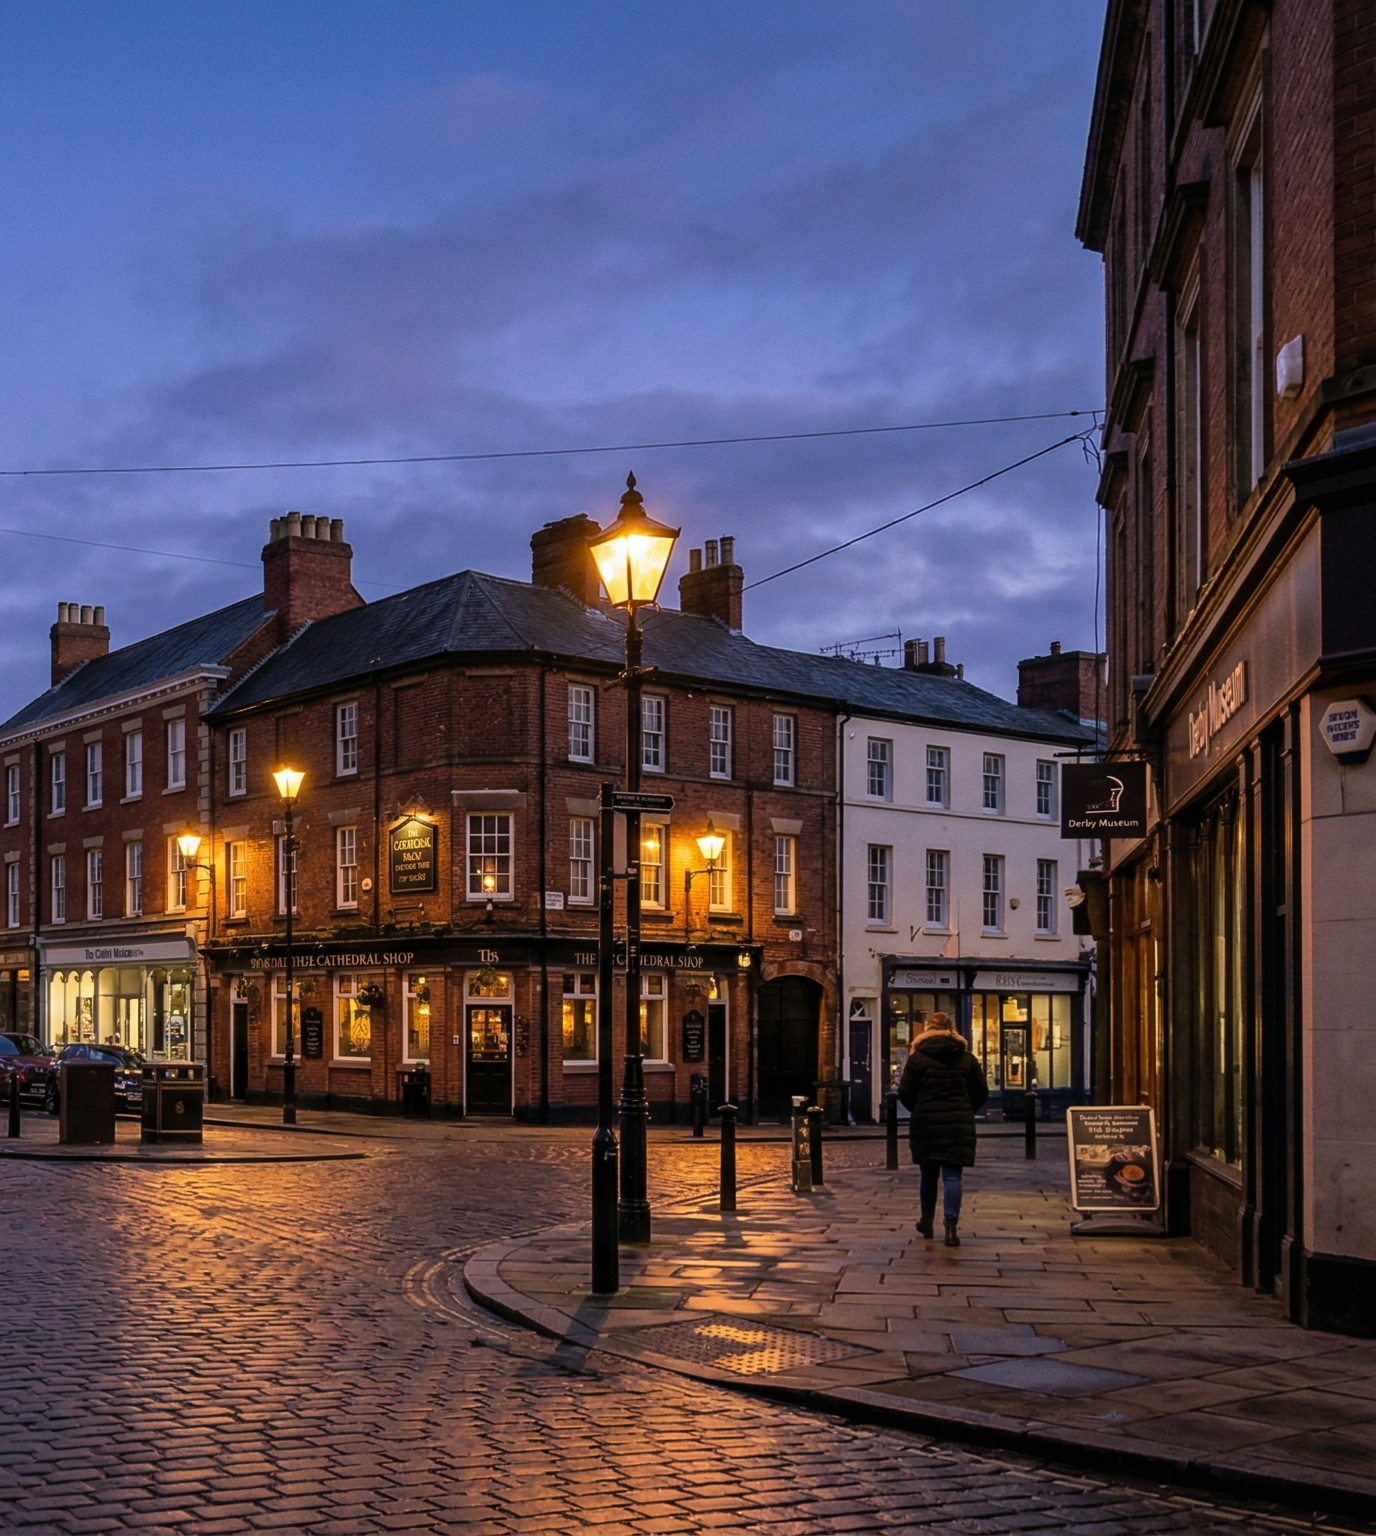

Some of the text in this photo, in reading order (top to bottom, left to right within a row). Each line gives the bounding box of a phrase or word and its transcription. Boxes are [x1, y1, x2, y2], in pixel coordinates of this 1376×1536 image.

[1068, 819, 1139, 829] Derby Museum
[316, 953, 381, 966] CATHEDRAL
[383, 952, 414, 965] SHOP
[574, 953, 597, 965] THE
